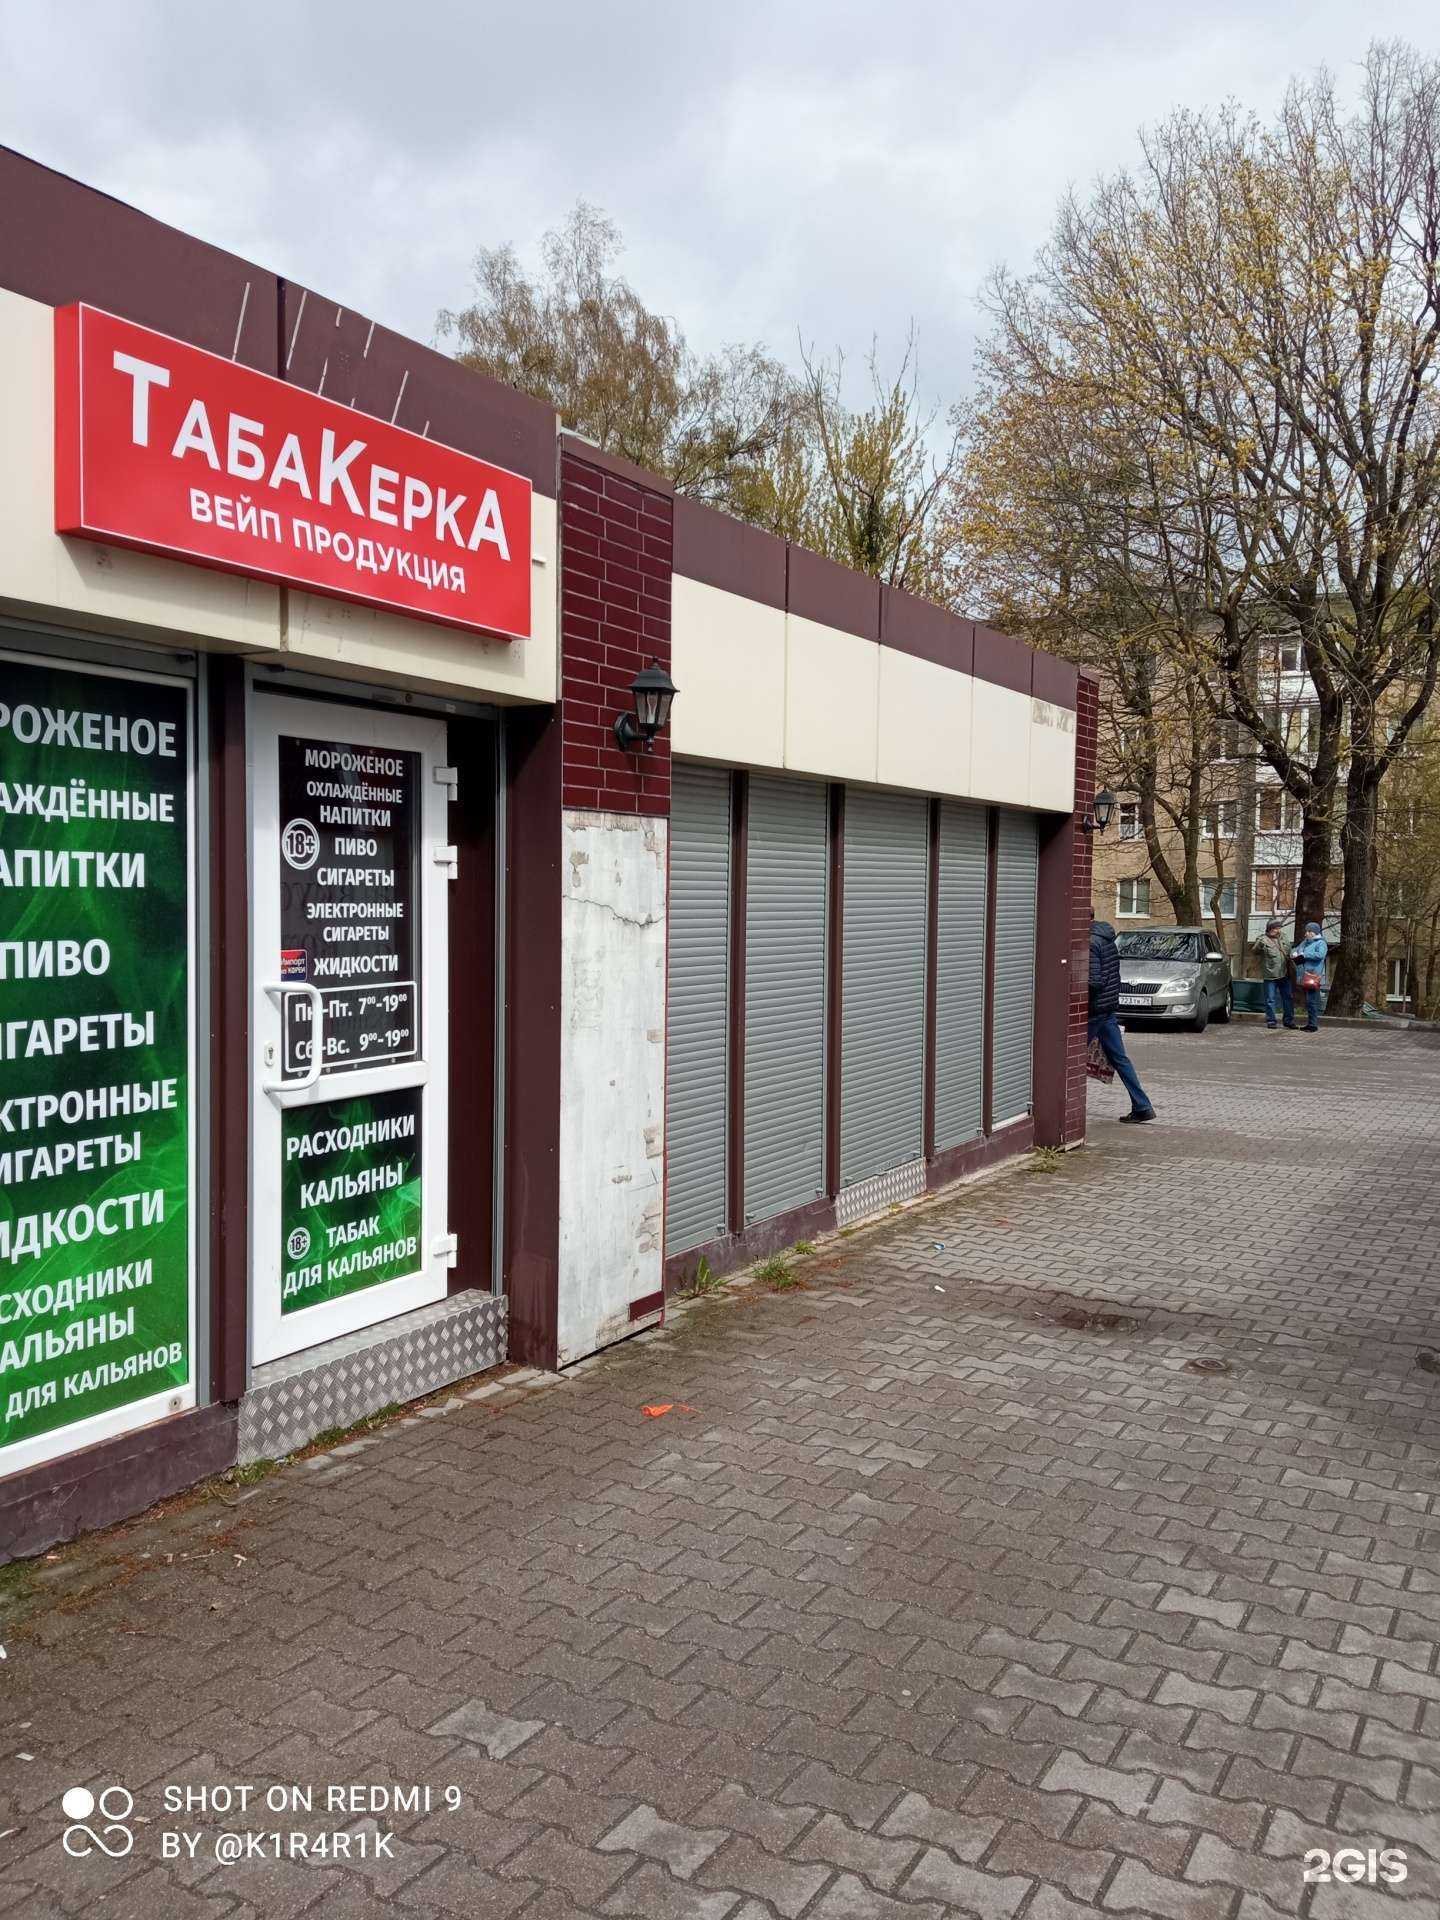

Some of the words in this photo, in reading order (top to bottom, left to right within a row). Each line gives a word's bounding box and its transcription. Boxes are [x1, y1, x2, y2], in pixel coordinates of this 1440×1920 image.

[190, 488, 282, 544] ВЕЙП
[293, 520, 466, 594] ПРОДУКЦИЯ
[304, 748, 404, 777] МОРОЖЕНОЕ
[306, 780, 403, 804] ОХЛАЖДЁННЫЕ
[319, 805, 392, 828] НАПИТКИ
[286, 829, 315, 858] 18+
[334, 837, 378, 857] ПИВО
[316, 867, 395, 887] СИГАРЕТЫ
[306, 902, 404, 920] ЭЛЕКТРОННЫЕ
[322, 925, 390, 943] СИГАРЕТЫ
[0, 938, 111, 980] ПИВО
[313, 954, 399, 979] ЖИДКОСТИ
[0, 1010, 155, 1060] ГАРЕТЫ
[285, 1114, 416, 1161] РАСХОДНИКИ
[300, 1162, 403, 1210] КАЛЬЯНЫ
[290, 1235, 308, 1253] 18+
[326, 1215, 380, 1248] ТАБАК
[283, 1263, 323, 1299] ДЛЯ
[327, 1235, 417, 1281] КАЛЬЯНОВ
[0, 1258, 153, 1325] СХОДНИКИ
[0, 1306, 135, 1374] АЛЬЯНЫ
[5, 1380, 57, 1423] ДЛЯ
[64, 1342, 183, 1399] КАЛЬЯНОВ
